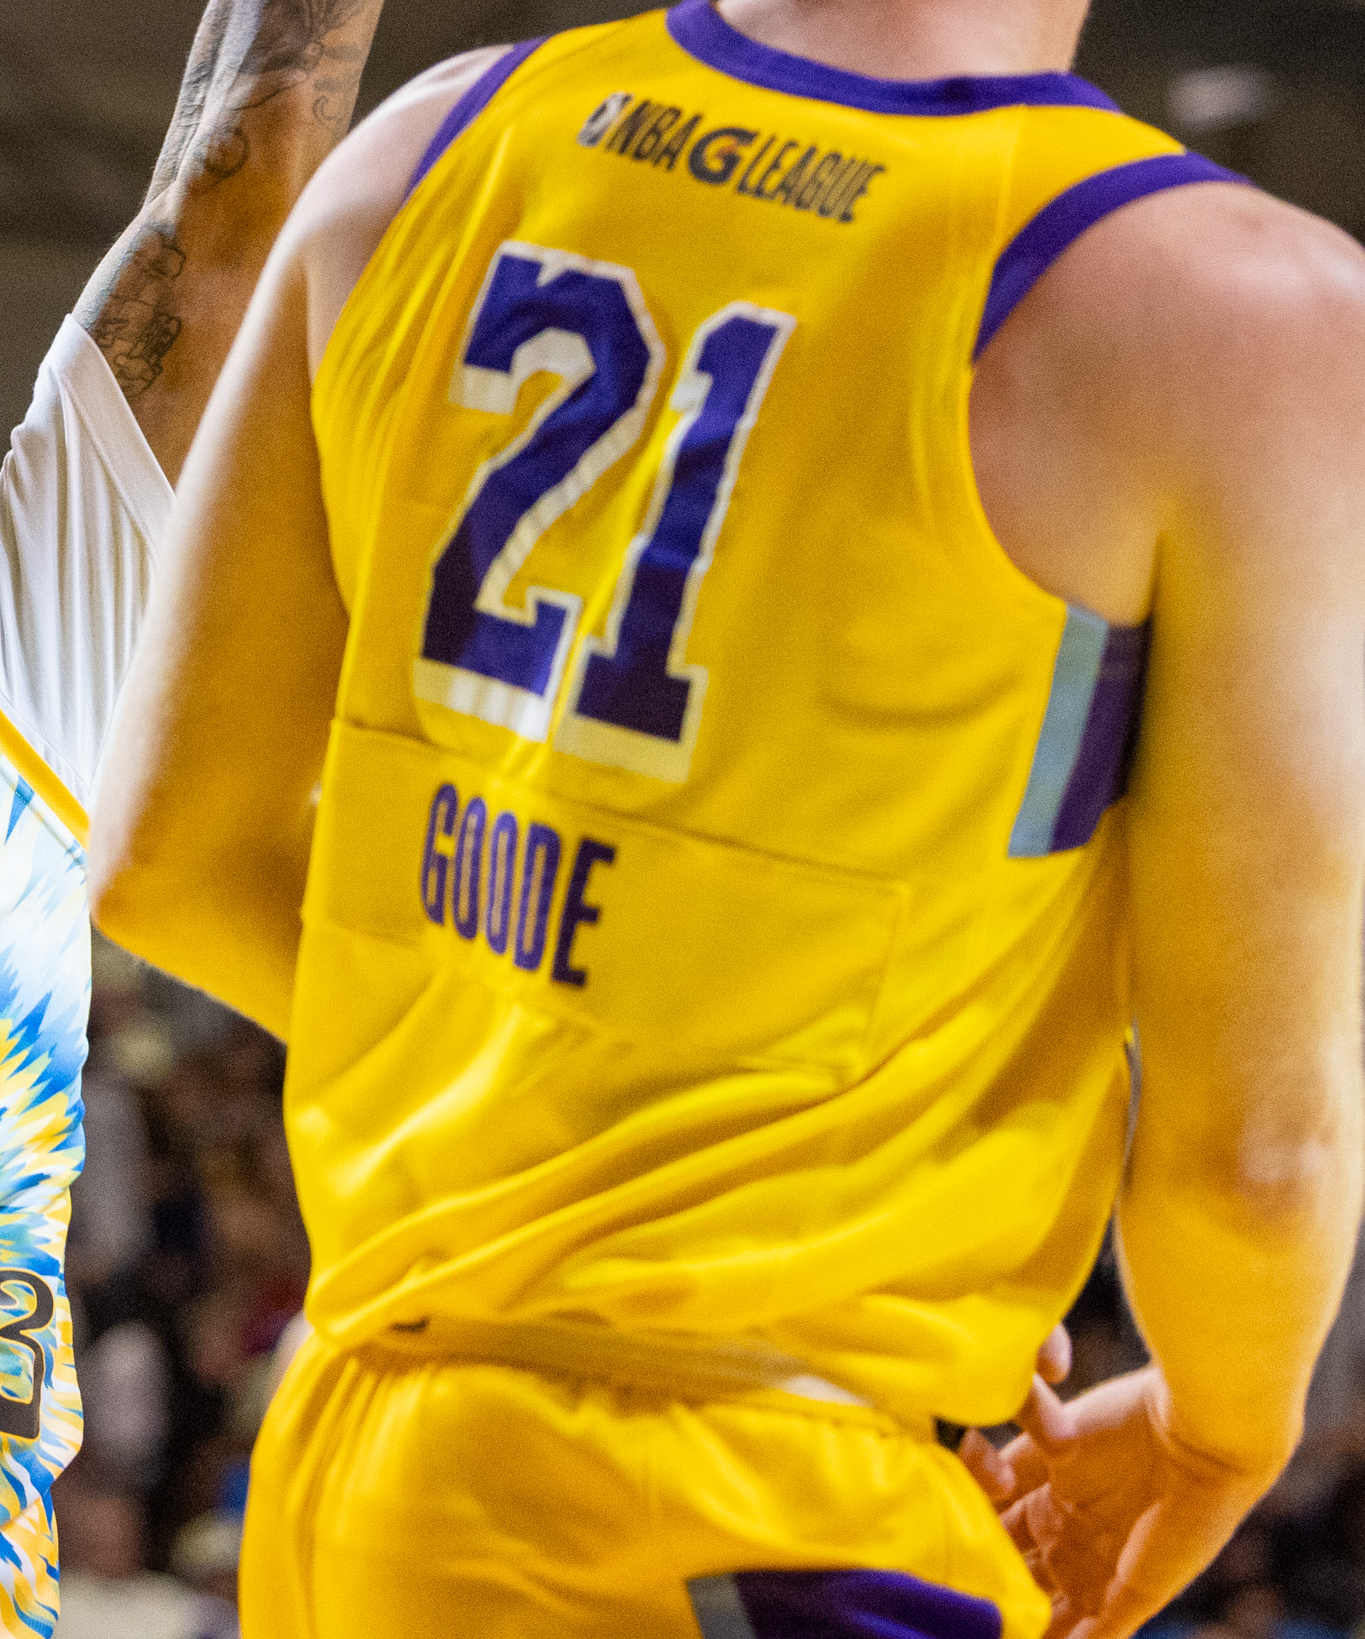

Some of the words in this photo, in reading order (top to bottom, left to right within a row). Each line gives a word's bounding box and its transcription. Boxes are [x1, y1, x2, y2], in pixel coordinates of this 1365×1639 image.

[605, 100, 701, 172] NBA
[735, 135, 887, 224] LEAGUE
[412, 240, 797, 784] 21
[420, 782, 619, 988] GOODE
